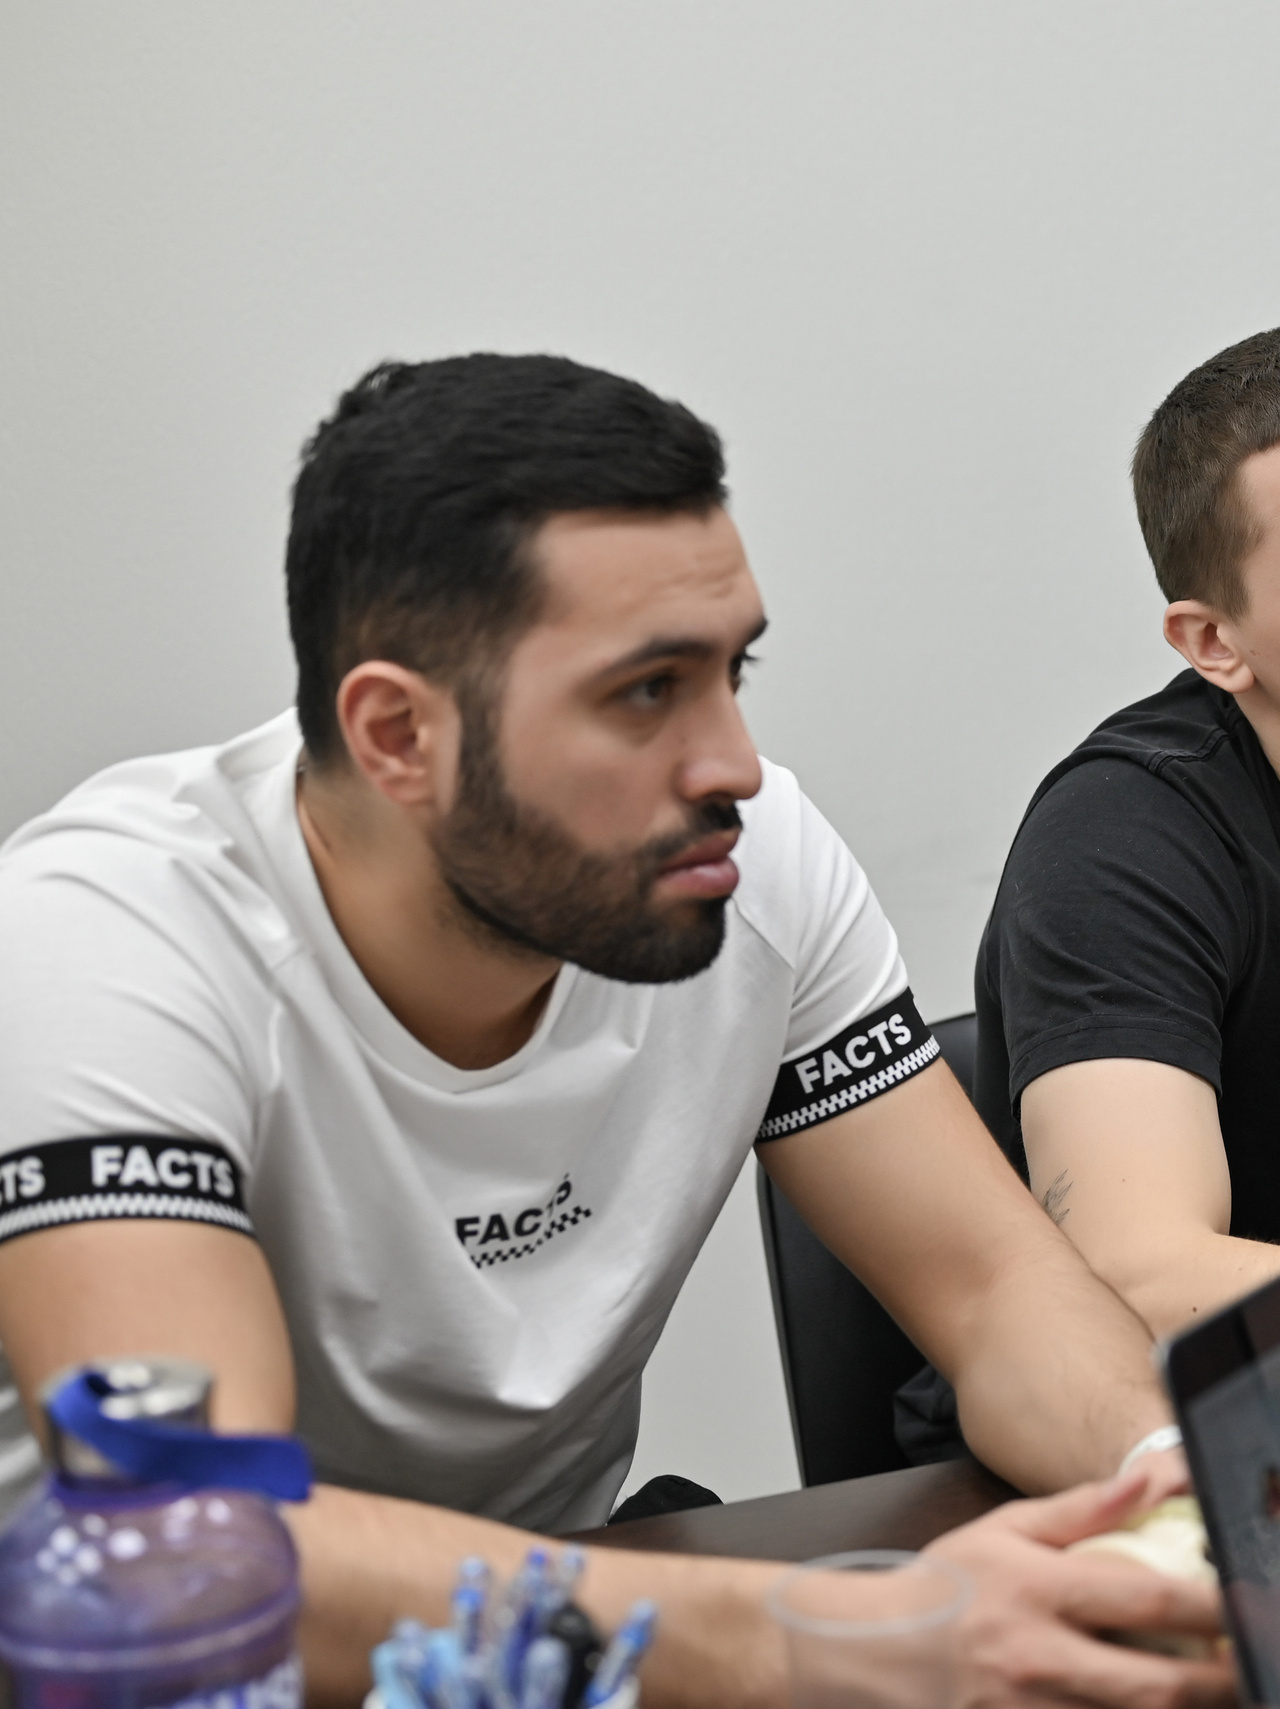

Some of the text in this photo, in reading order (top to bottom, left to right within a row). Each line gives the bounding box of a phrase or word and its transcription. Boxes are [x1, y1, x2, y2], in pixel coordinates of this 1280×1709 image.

[794, 1013, 912, 1094] FACTS
[0, 1155, 46, 1204] TS
[90, 1145, 235, 1197] FACTS
